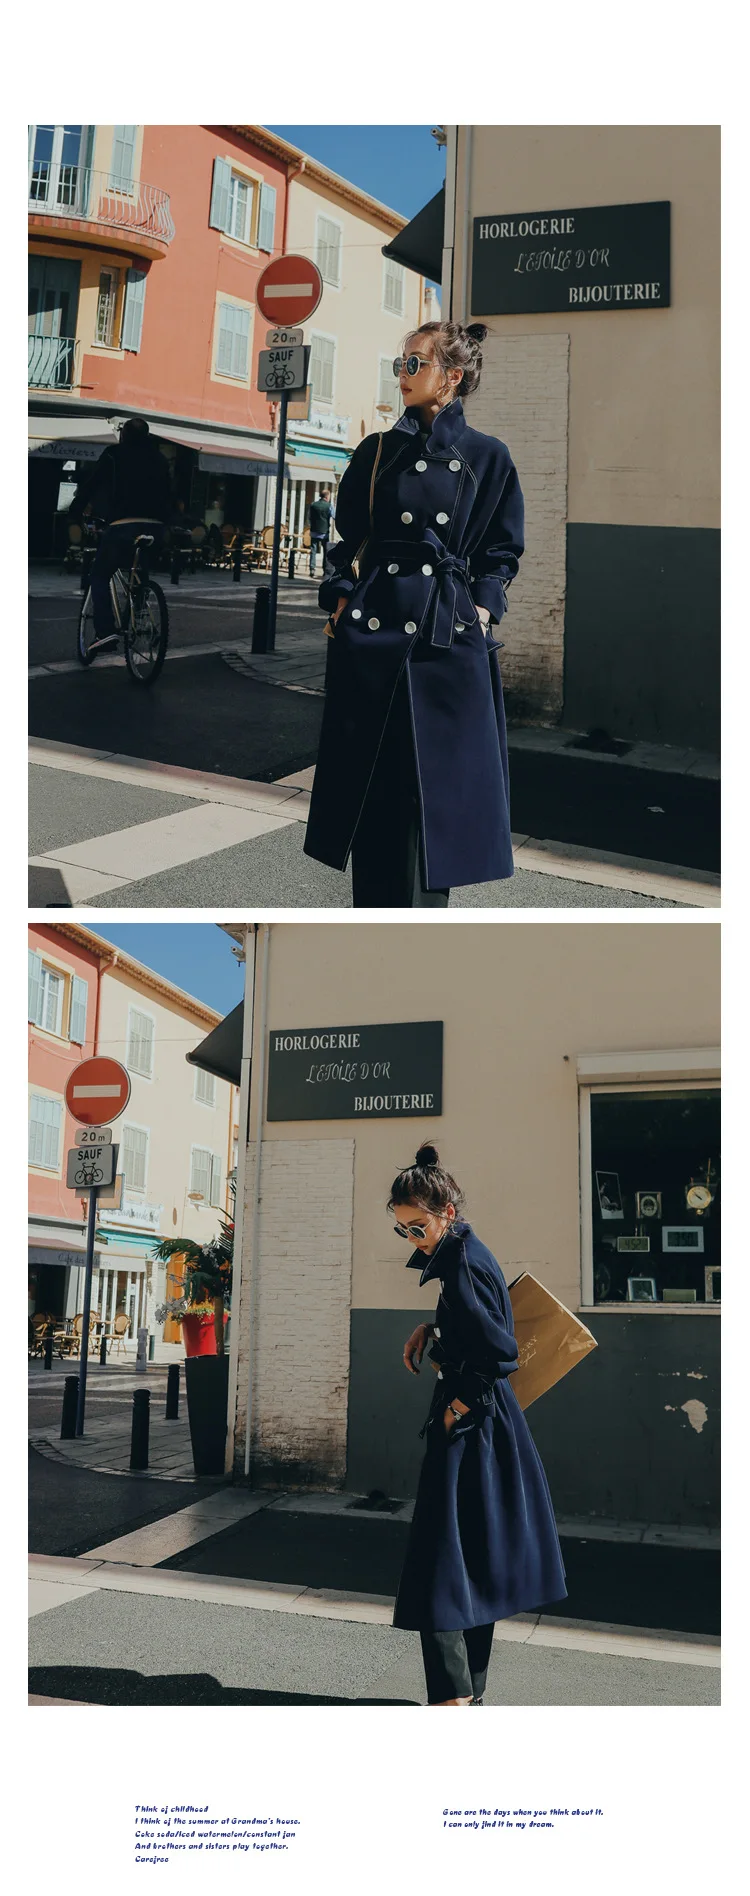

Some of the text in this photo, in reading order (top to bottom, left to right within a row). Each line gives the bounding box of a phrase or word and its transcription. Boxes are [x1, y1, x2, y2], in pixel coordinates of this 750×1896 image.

[479, 217, 575, 239] HORLOGERIE
[575, 247, 610, 268] D'OR
[568, 282, 661, 303] BIJOUTERIE
[268, 349, 295, 363] SAUF
[38, 442, 96, 457] Oliviers
[274, 1033, 361, 1051] HORLOGERIE
[360, 1061, 391, 1080] D'OR
[354, 1093, 434, 1111] BIJOUTERIE
[77, 1148, 103, 1161] SAUF
